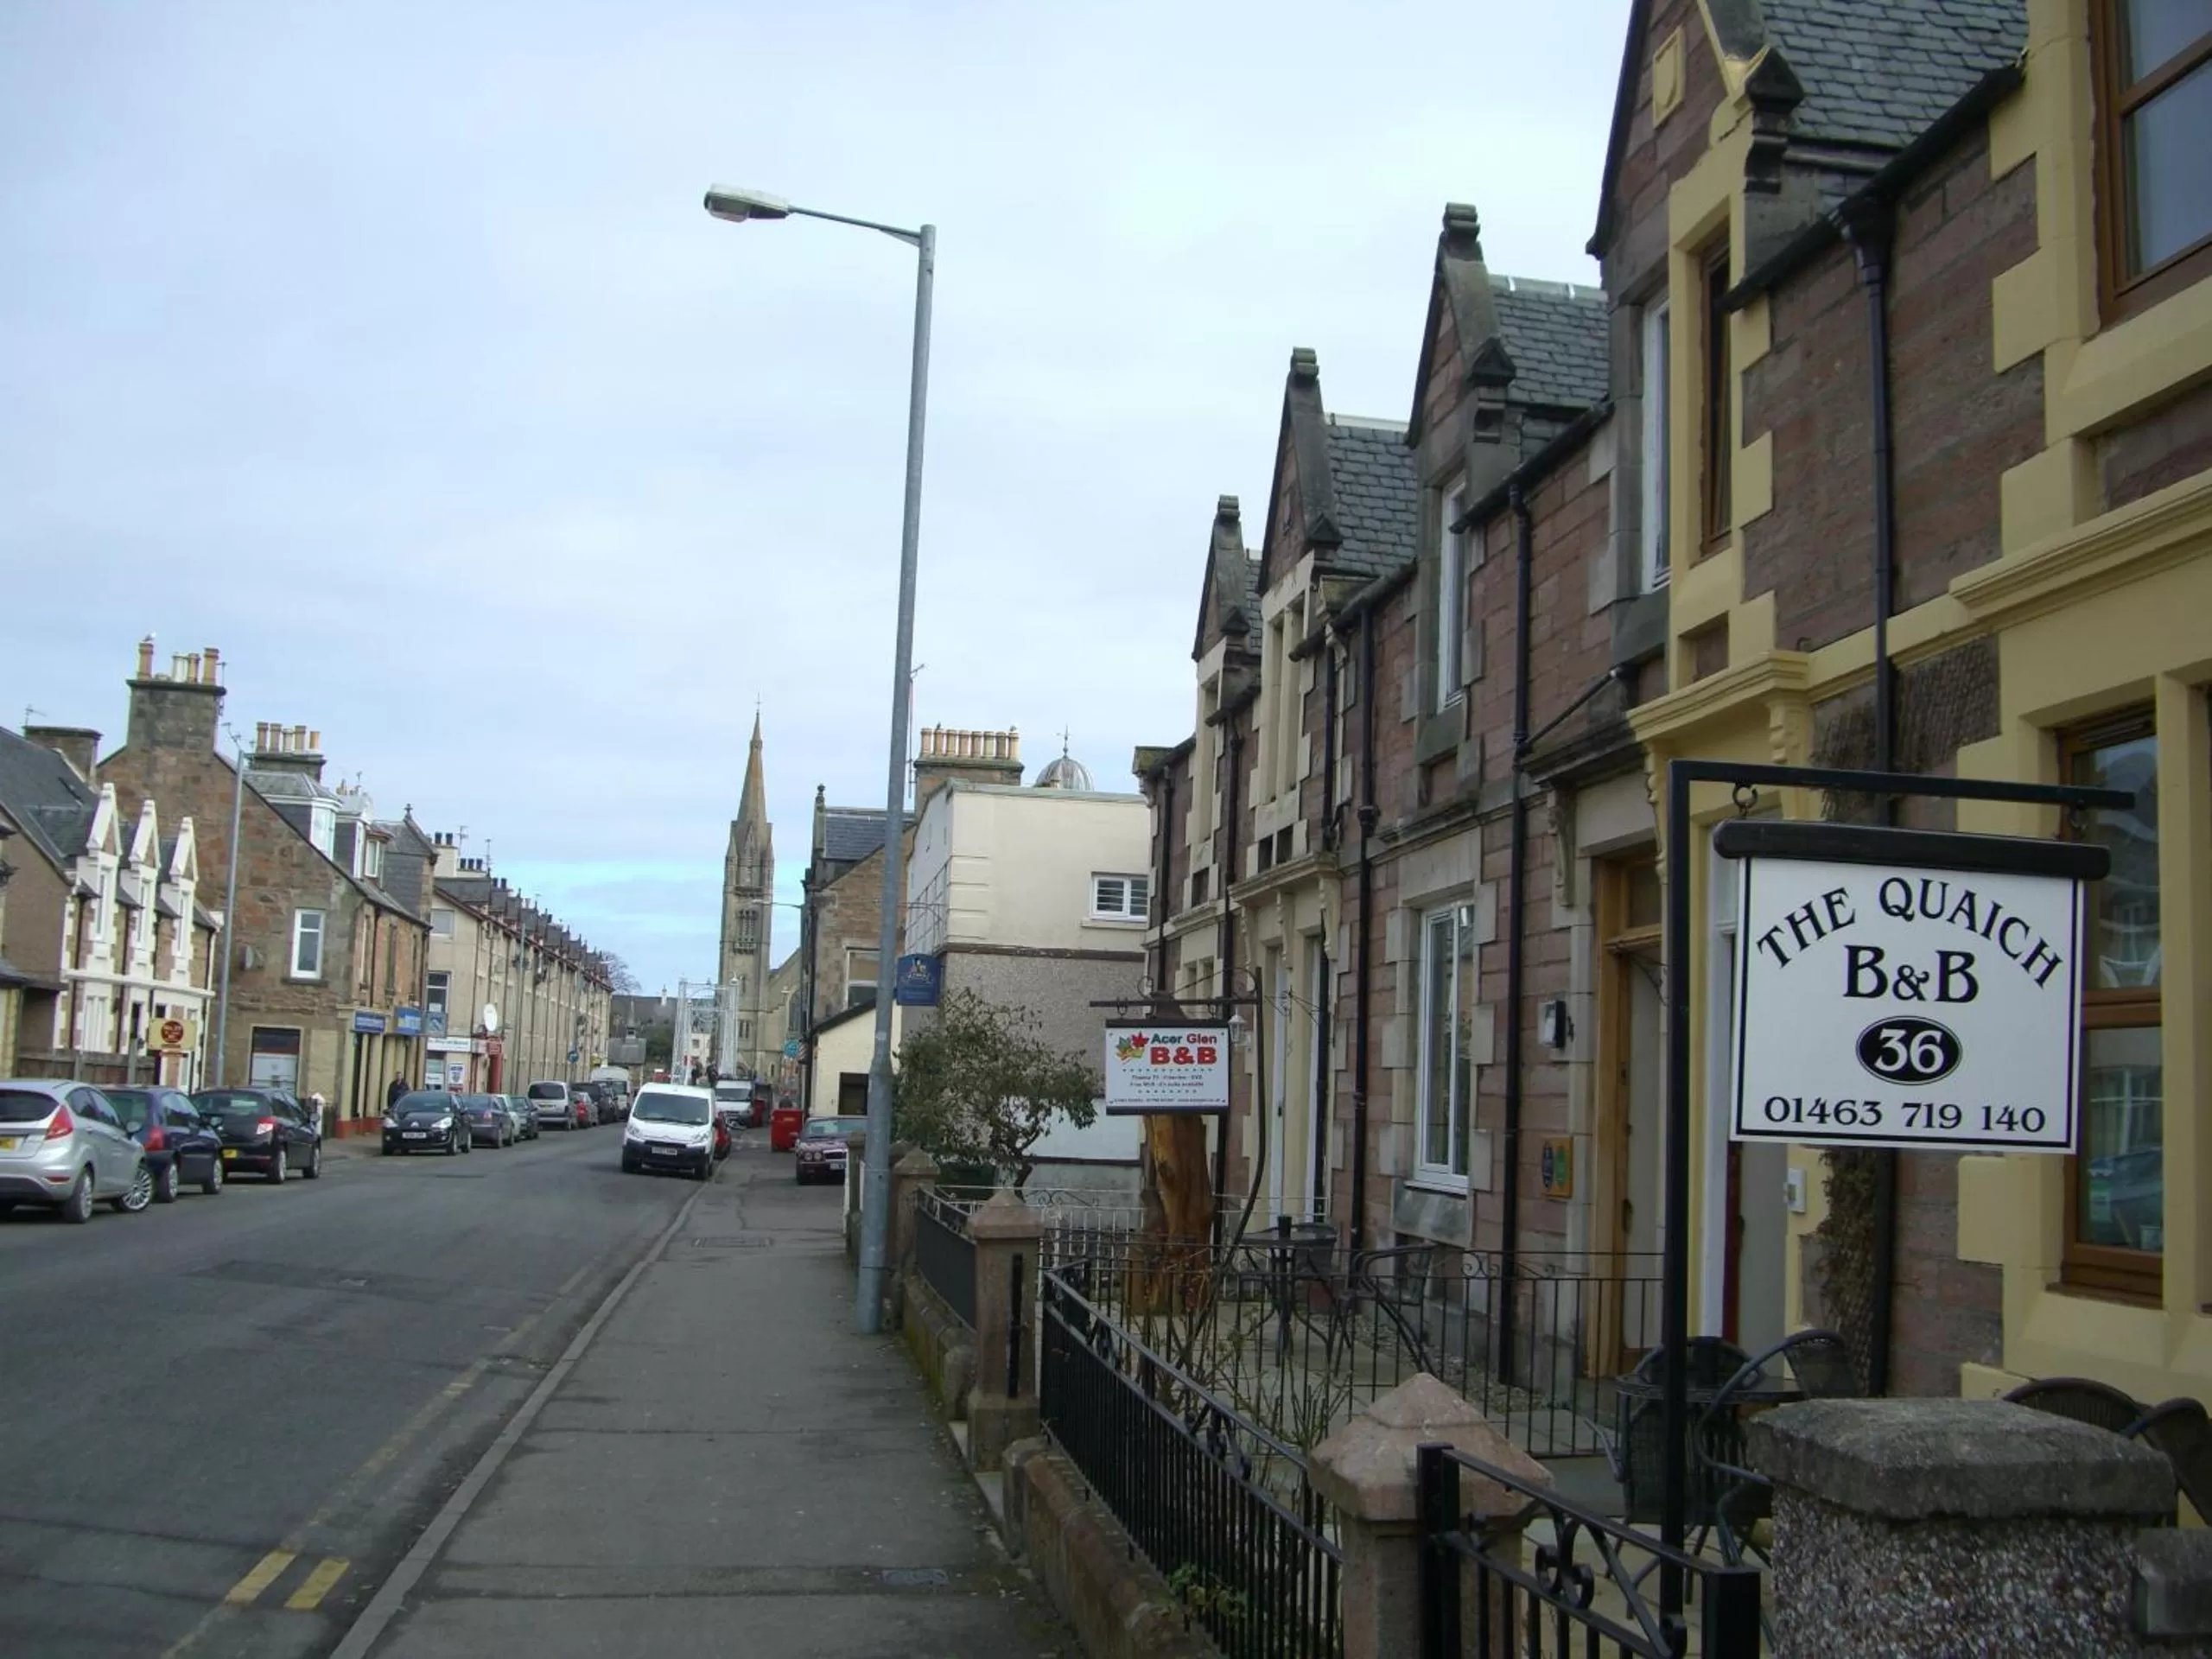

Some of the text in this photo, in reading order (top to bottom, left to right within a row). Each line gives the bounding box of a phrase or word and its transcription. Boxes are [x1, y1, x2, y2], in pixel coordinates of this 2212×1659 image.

[1757, 877, 2063, 989] THE QUAICH
[1842, 944, 1979, 1003] B&B
[1150, 1046, 1217, 1065] B&B
[1151, 1033, 1217, 1045] Acer Glen
[1873, 1028, 1944, 1073] 36
[1764, 1096, 2045, 1133] 01463 719 140
